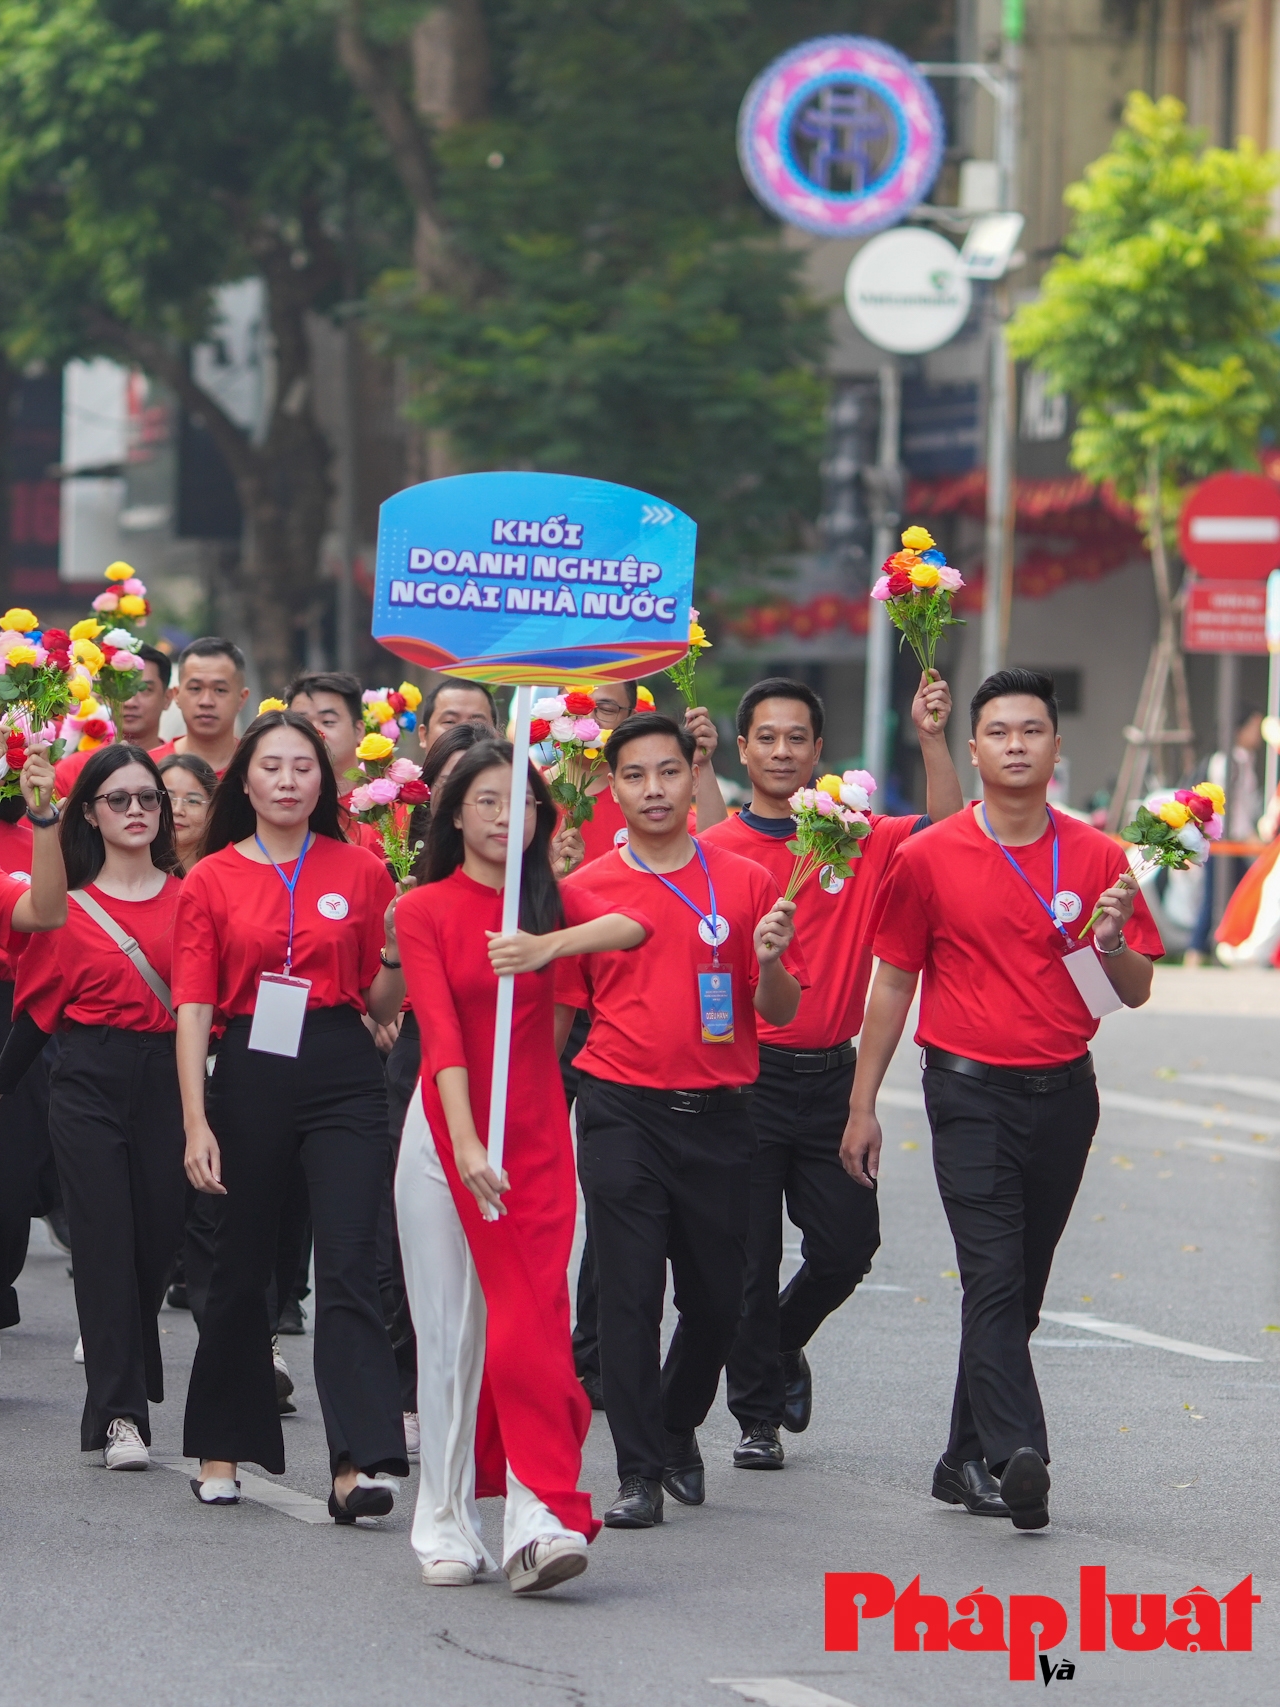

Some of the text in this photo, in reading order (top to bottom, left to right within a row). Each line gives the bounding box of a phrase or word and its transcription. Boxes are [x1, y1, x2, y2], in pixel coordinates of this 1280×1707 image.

[492, 515, 583, 549] KHỐI
[409, 548, 662, 591] DOANH NGHIỆP
[390, 579, 676, 622] NGOÀI NHÀ NƯỚC
